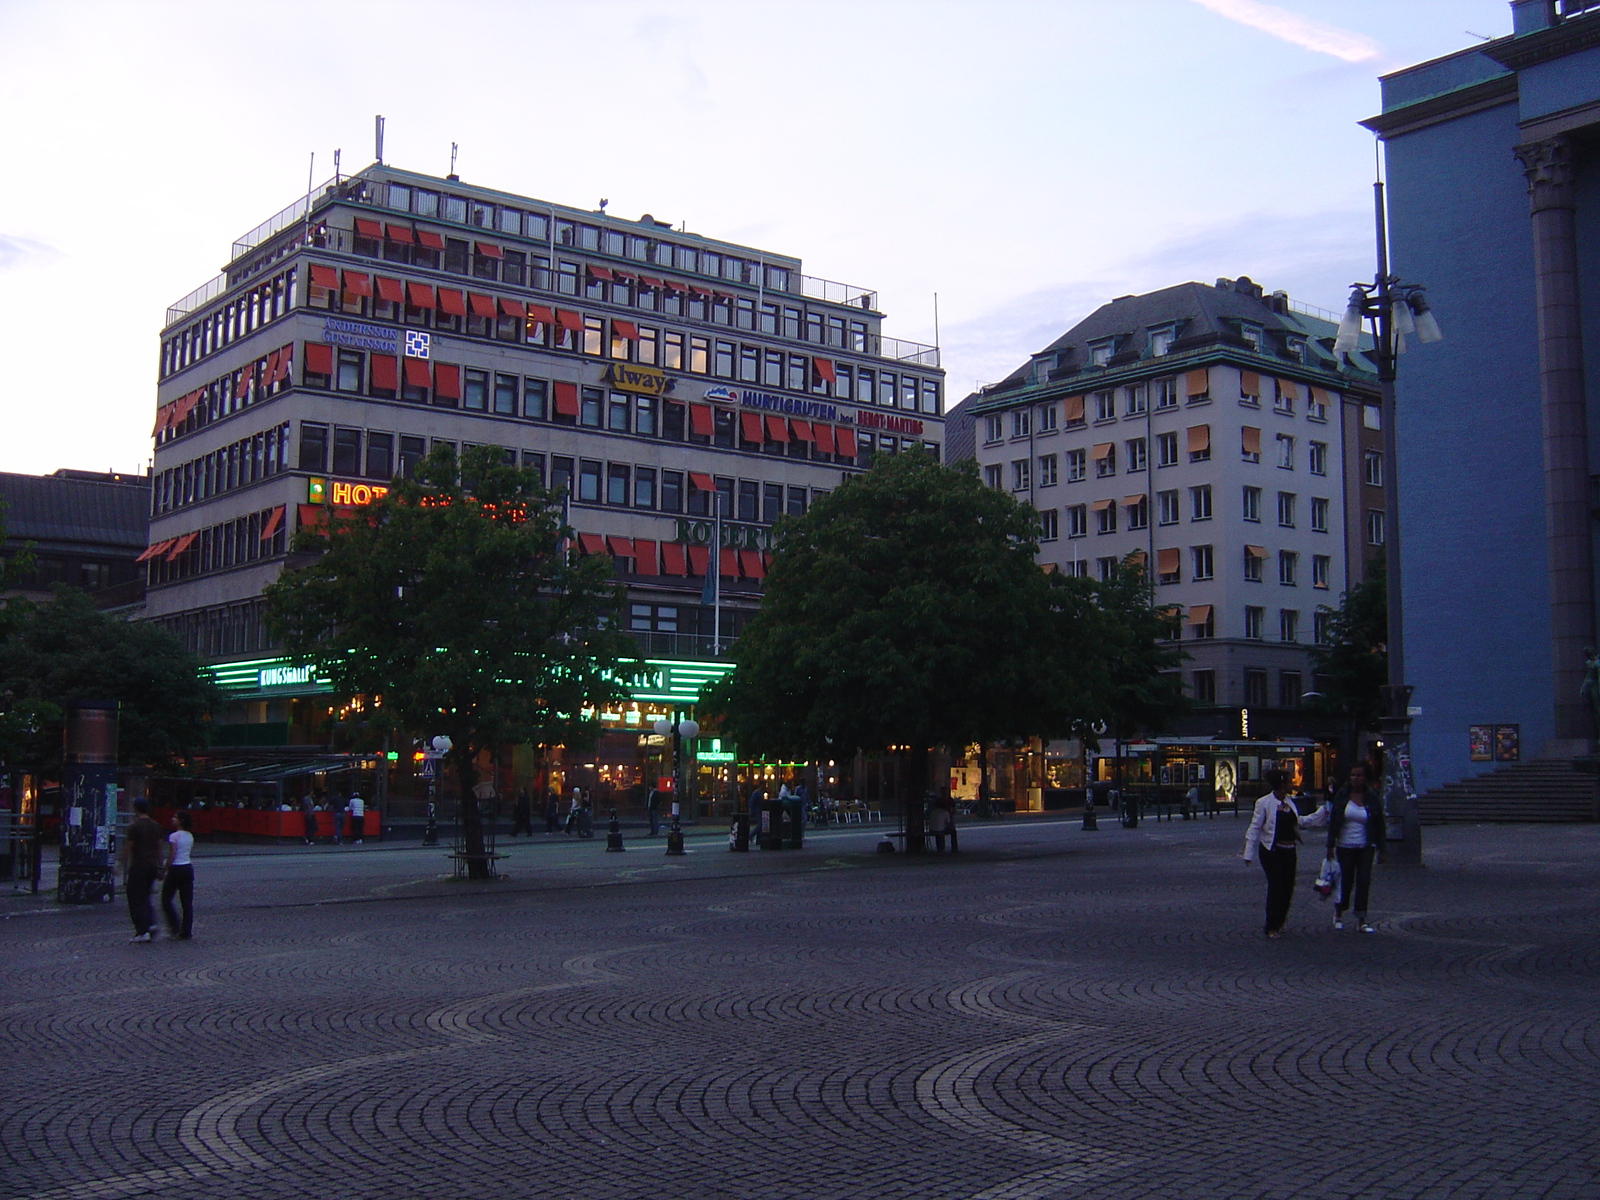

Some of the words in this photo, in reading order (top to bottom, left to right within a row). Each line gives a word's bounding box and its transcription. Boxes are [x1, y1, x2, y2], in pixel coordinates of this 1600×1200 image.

[322, 329, 397, 353] GUSTAFSSON
[325, 317, 398, 340] ANDERSSON
[602, 363, 678, 394] Always
[741, 390, 837, 420] HURTIGRUTEN
[333, 482, 388, 505] HOT
[675, 519, 776, 552] ROBERT
[1241, 708, 1249, 738] GRANIT
